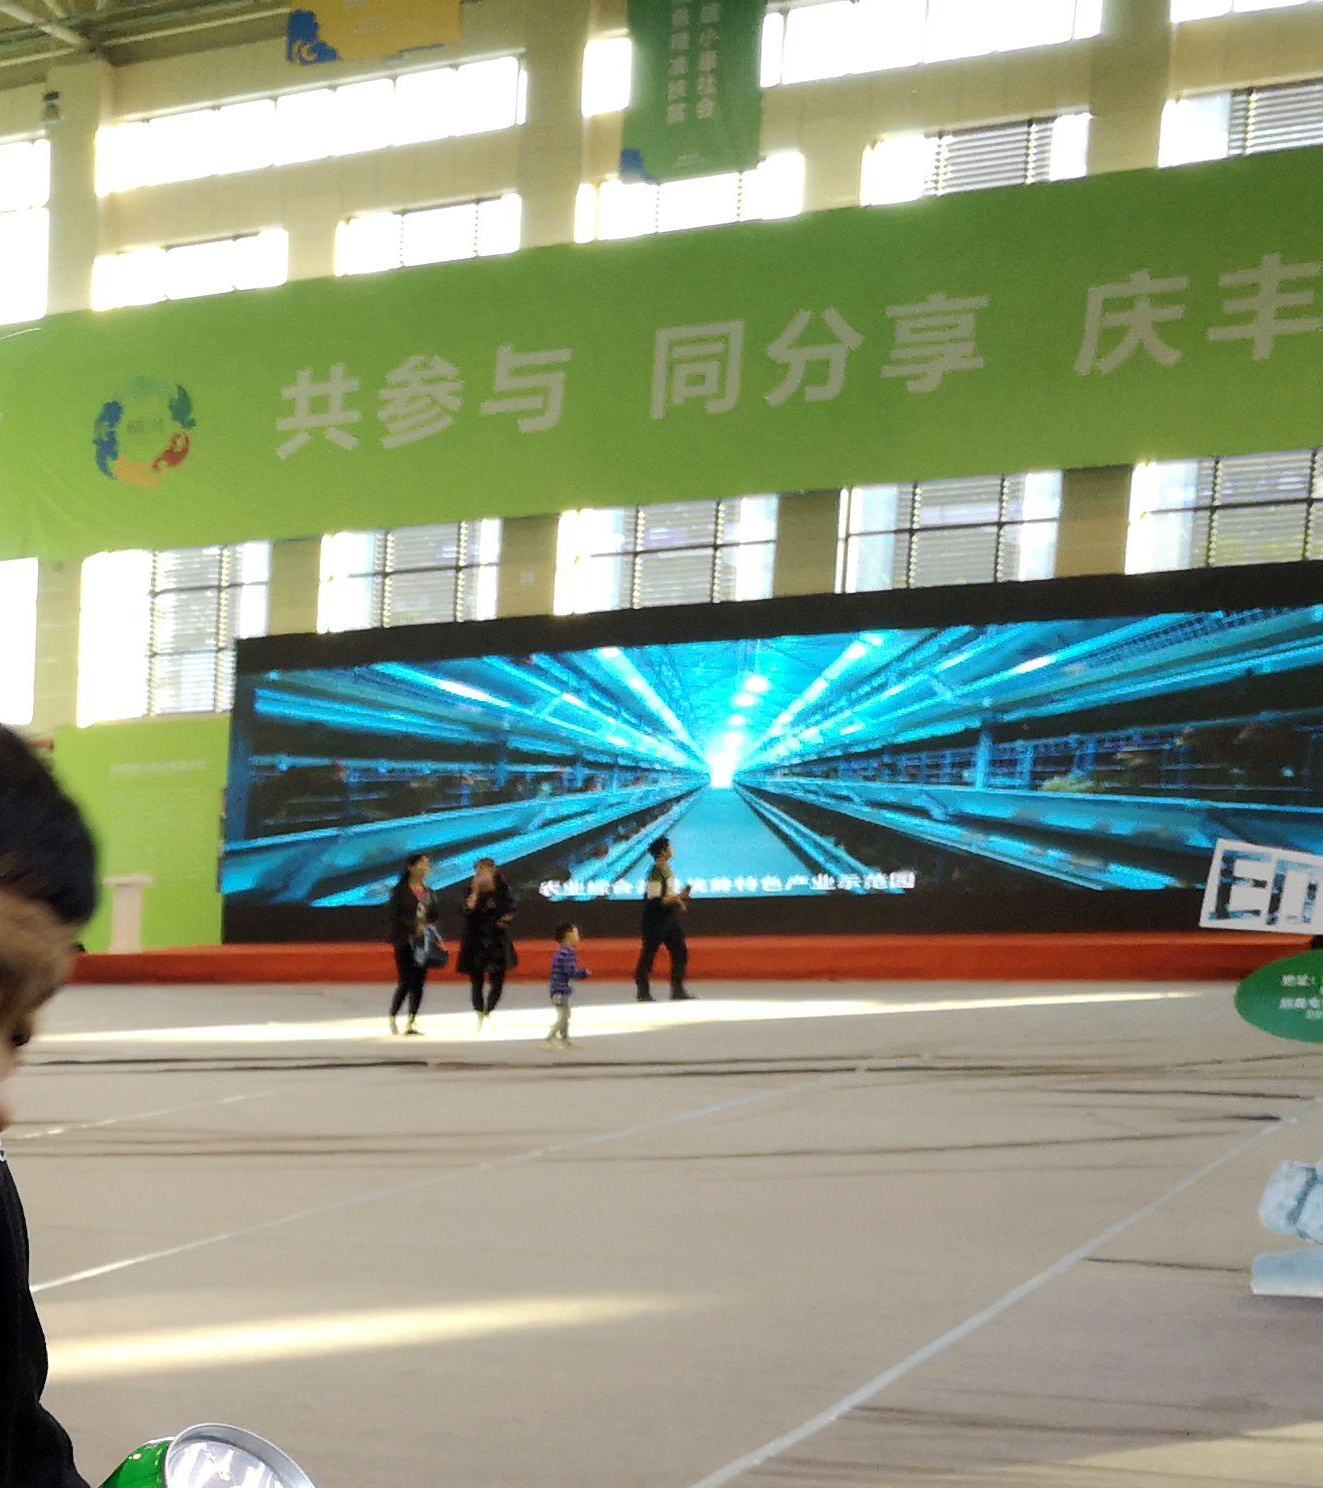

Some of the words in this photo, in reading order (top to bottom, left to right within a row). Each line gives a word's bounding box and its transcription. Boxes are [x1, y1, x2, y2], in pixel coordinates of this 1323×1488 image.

[275, 343, 575, 460] 共参与
[648, 292, 990, 420] 同分享
[1073, 252, 1323, 376] 庆丰
